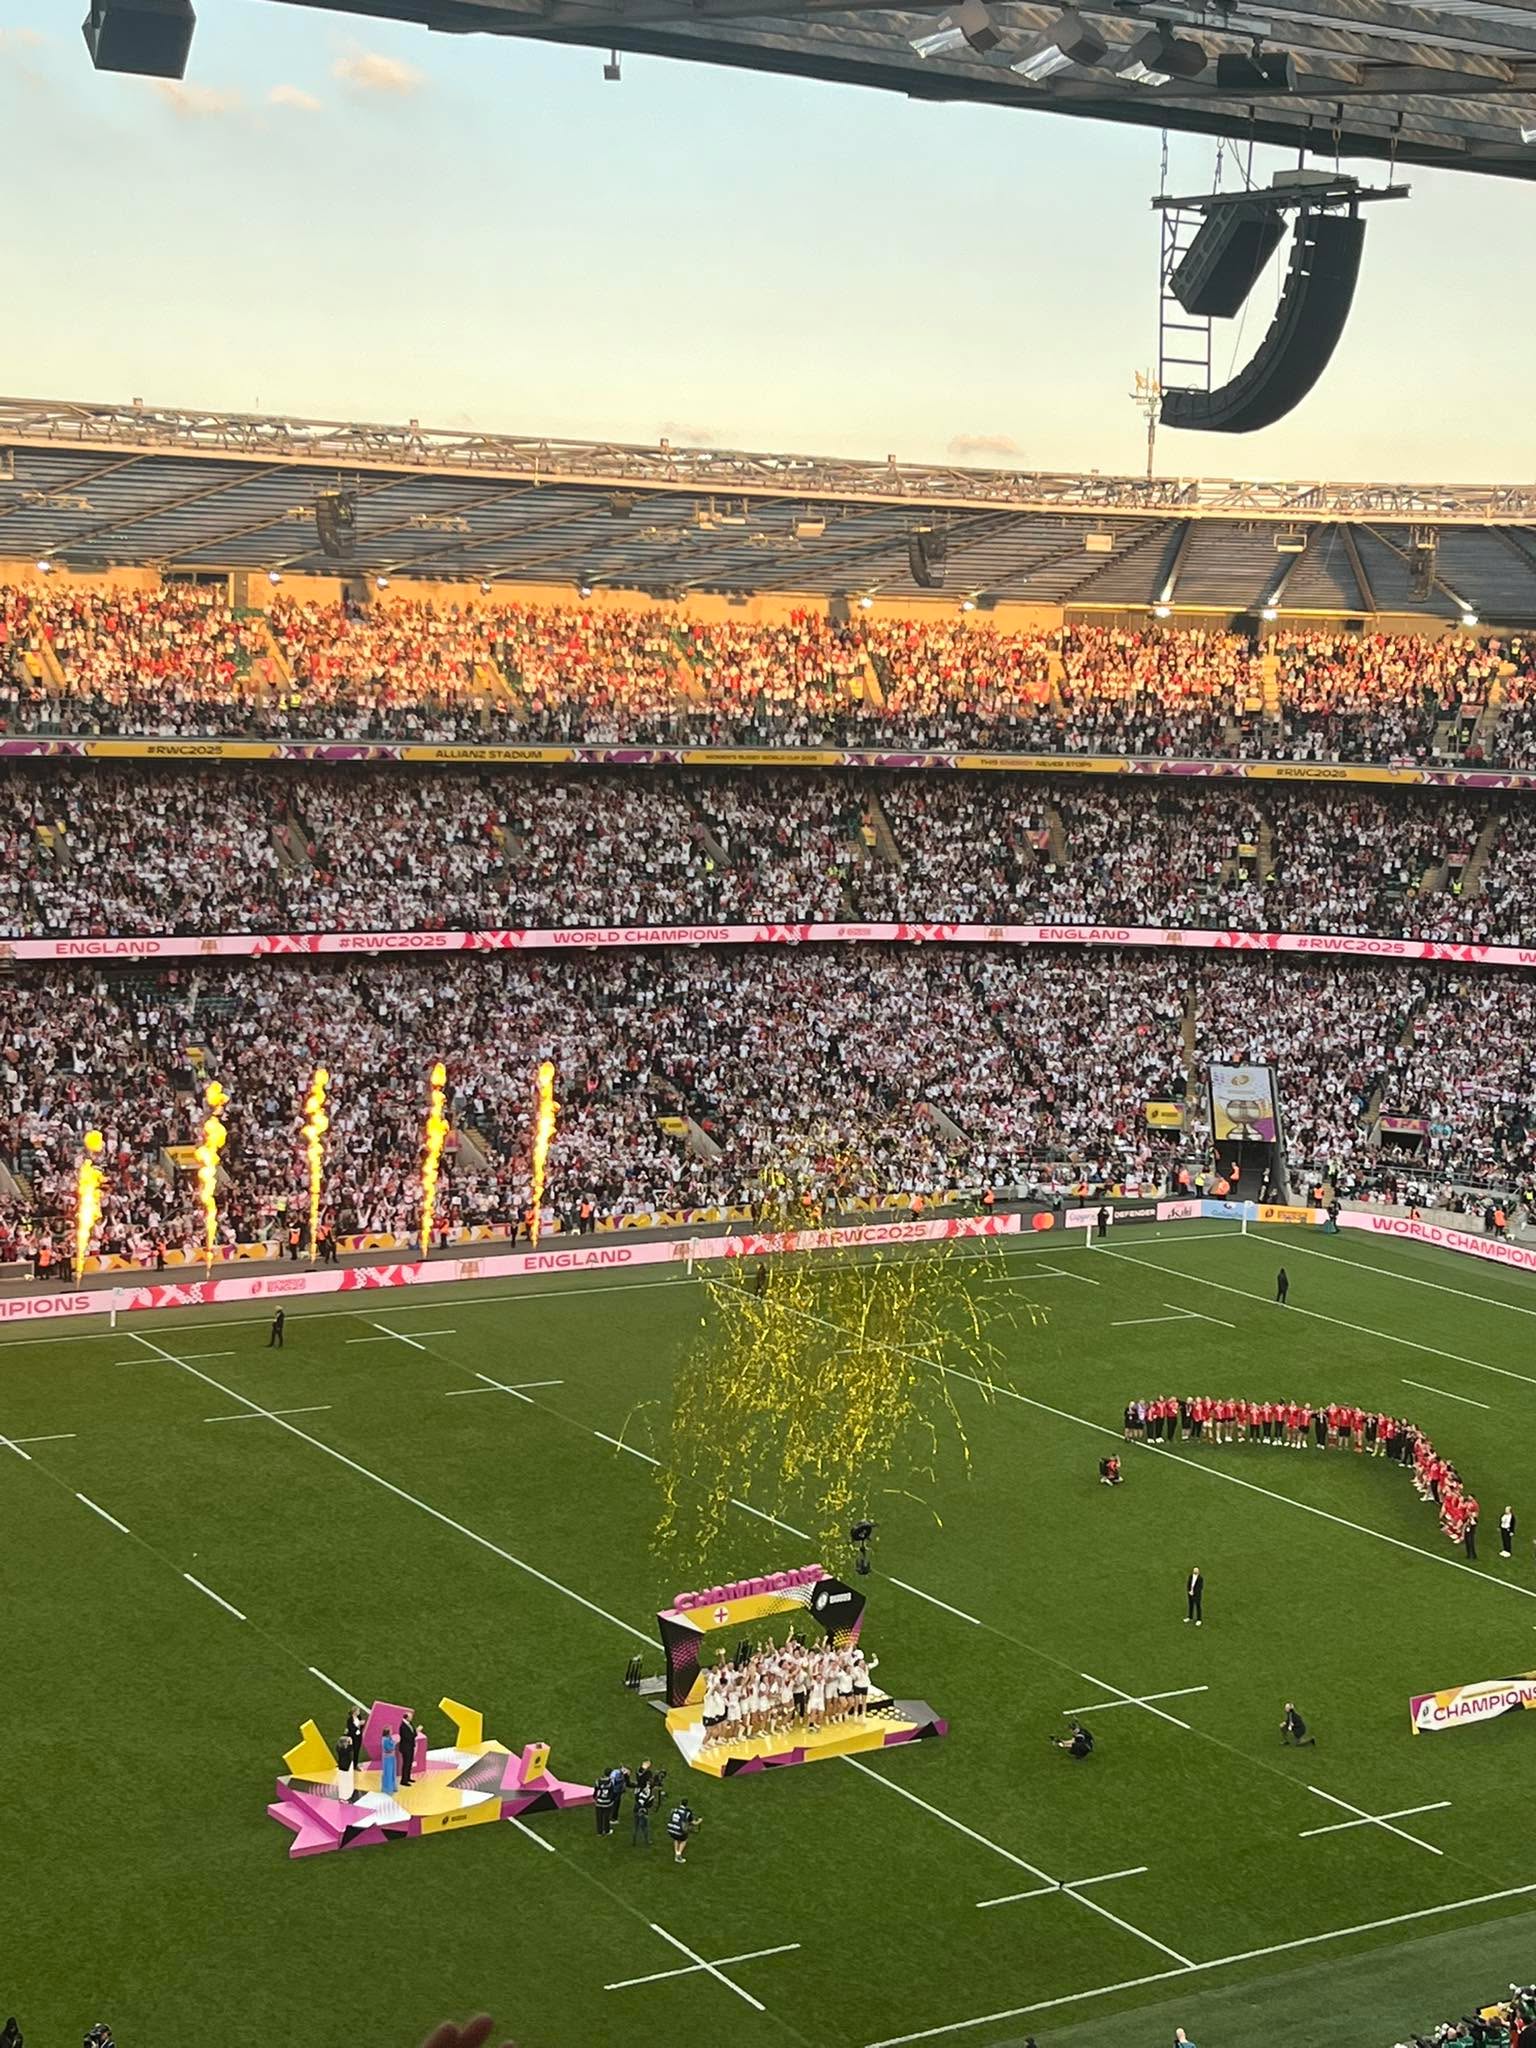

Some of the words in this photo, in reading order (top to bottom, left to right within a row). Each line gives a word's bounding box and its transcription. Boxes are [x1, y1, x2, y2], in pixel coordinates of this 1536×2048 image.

[147, 746, 223, 755] #RWC2025
[435, 750, 487, 758] ALLIANZ
[488, 750, 543, 759] STADIUM
[1277, 768, 1347, 778] #RWC2025
[553, 931, 620, 943] WORLD
[625, 929, 729, 941] CHAMPIONS
[1039, 928, 1130, 940] ENGLAND
[56, 941, 160, 954] ENGLAND
[339, 935, 447, 948] #RWC2025
[1297, 938, 1405, 953] #RWC2025
[1114, 1208, 1156, 1219] DEFENDER
[816, 1224, 927, 1246] #RWC2025
[1372, 1217, 1442, 1241] WORLD
[524, 1249, 632, 1270] ENGLAND
[673, 1563, 823, 1609] CHAMPIONS
